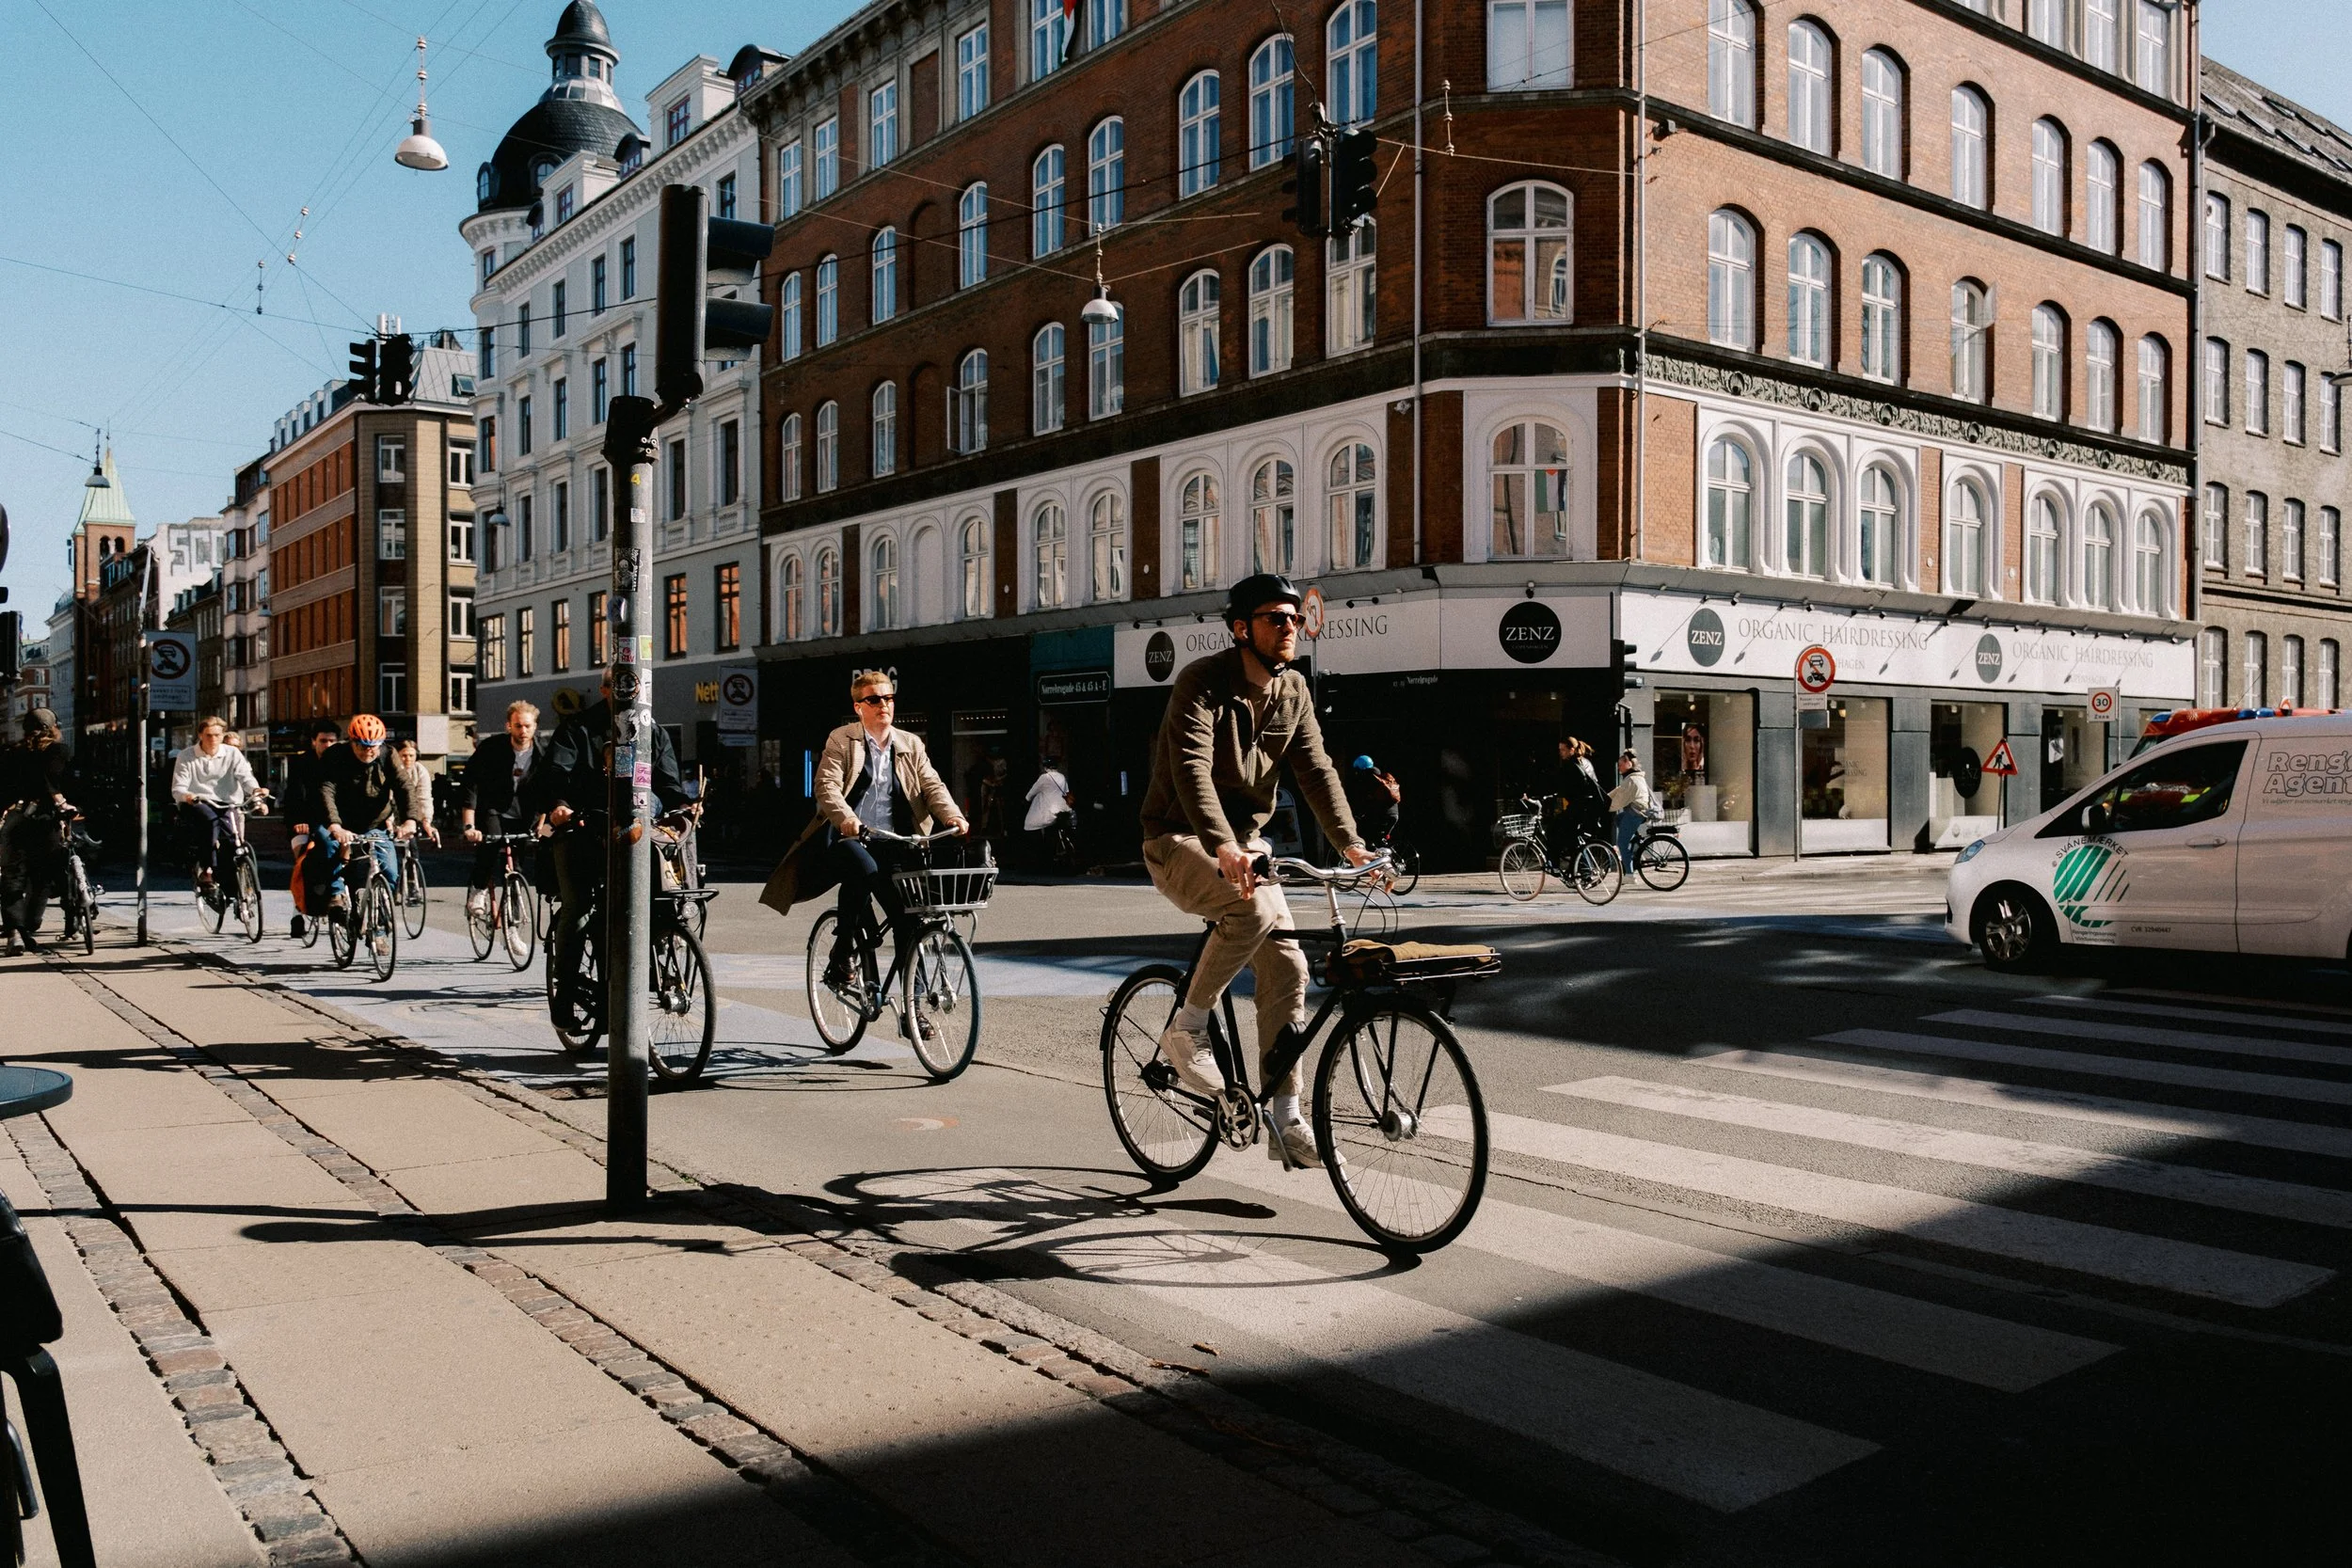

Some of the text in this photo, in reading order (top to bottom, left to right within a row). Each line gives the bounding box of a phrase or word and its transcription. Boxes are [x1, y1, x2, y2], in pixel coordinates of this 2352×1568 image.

[1186, 631, 1235, 652] ORGAN
[1505, 626, 1555, 641] ZENZ
[1691, 629, 1723, 646] ZENZ
[1739, 618, 1929, 651] ORGANIC HAIRDRESSING
[1148, 650, 1172, 664] ZENZ
[1978, 652, 2001, 665] ZENZ
[2013, 641, 2153, 668] ORGANIC HAIRDRESSING
[695, 681, 719, 702] Nett
[2095, 698, 2108, 707] 30
[2267, 750, 2352, 775] Reng
[2056, 835, 2129, 859] SVANEMÆRKET
